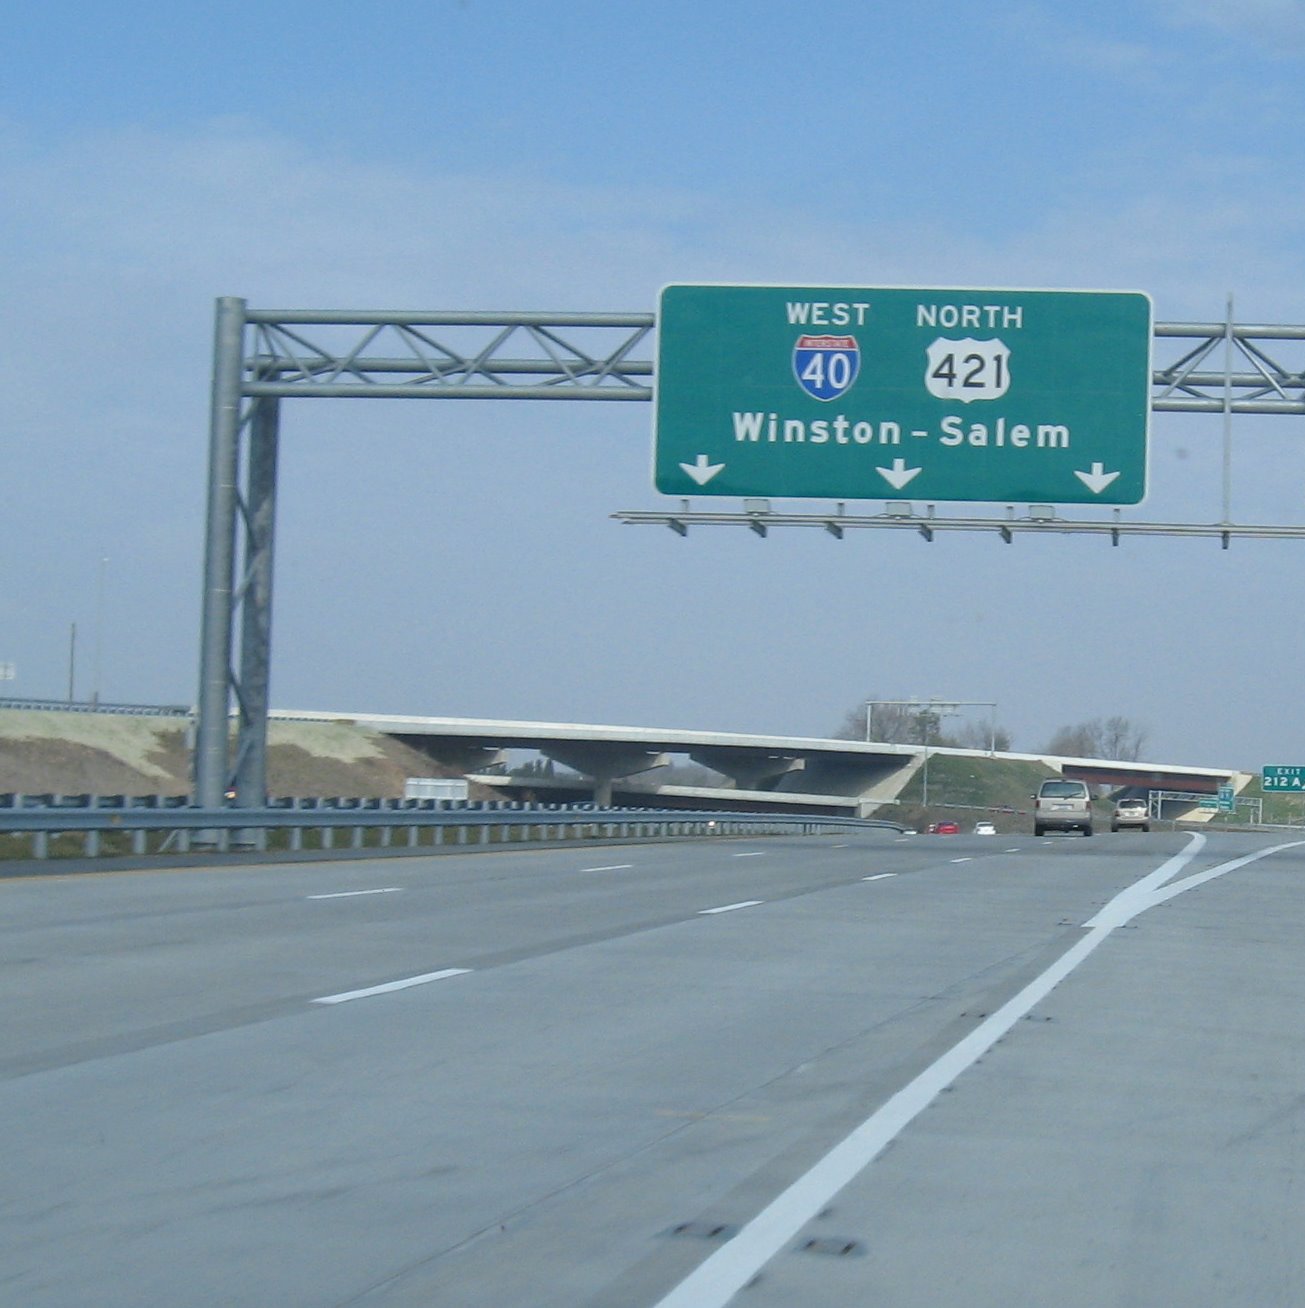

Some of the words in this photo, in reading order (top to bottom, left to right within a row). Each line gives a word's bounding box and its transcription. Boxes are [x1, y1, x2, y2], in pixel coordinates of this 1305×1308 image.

[786, 302, 871, 326] WEST
[916, 304, 1023, 329] NORTH
[801, 352, 851, 389] 40
[932, 353, 1003, 389] 421
[1277, 767, 1301, 775] EXIT
